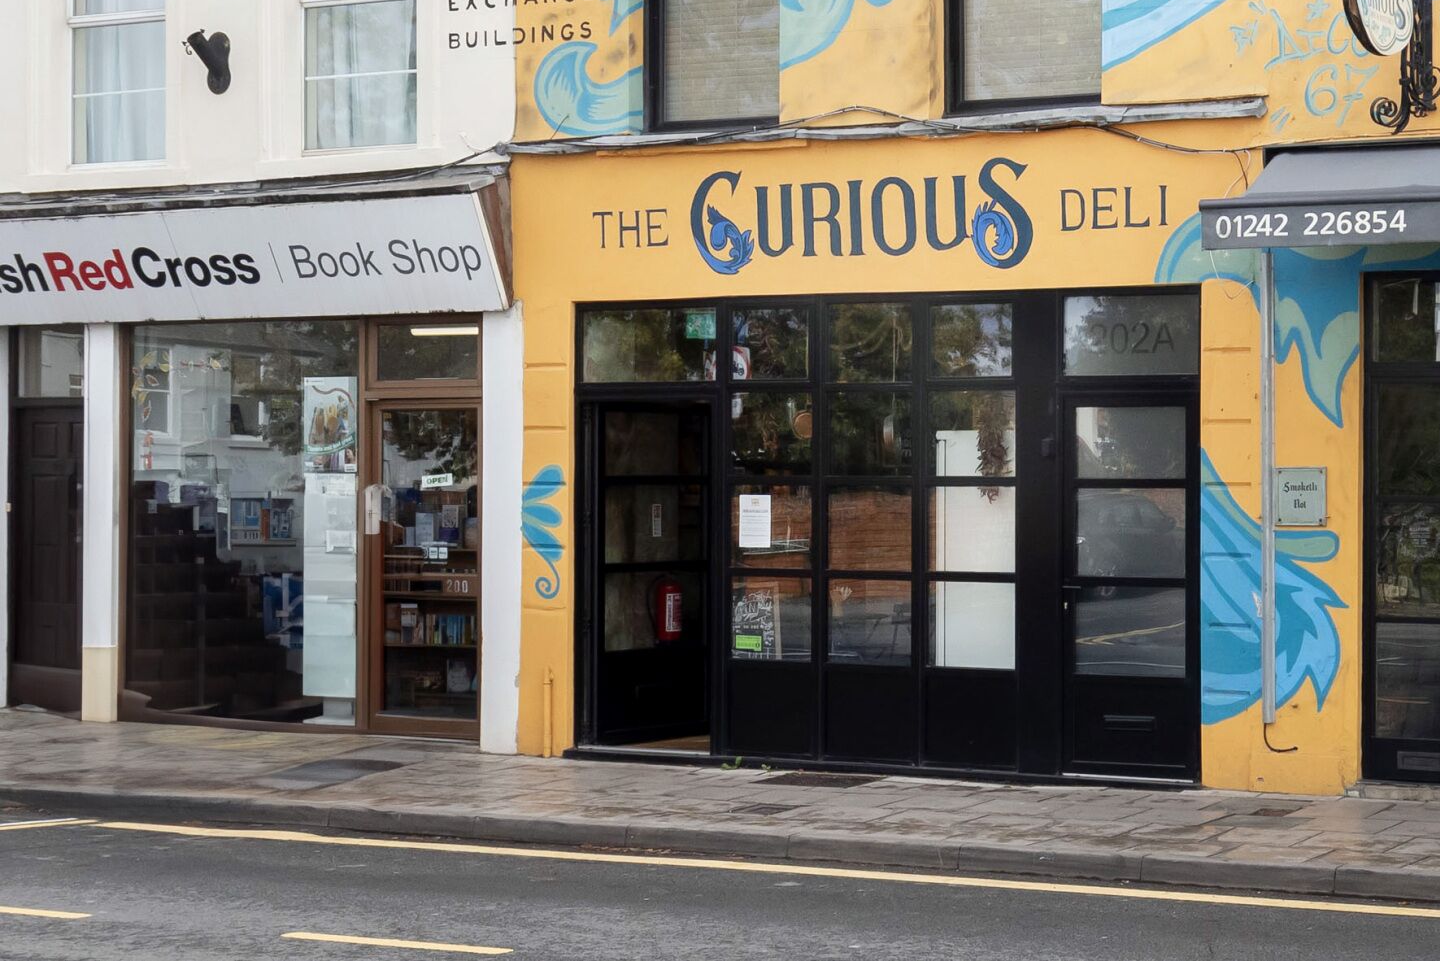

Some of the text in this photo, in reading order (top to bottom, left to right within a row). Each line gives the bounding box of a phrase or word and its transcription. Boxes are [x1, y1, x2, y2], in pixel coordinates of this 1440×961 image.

[448, 21, 593, 50] BUILDINGS
[1304, 63, 1380, 129] 67
[592, 208, 669, 249] THE
[689, 156, 1034, 276] CURIOUS
[1059, 184, 1169, 232] DELI
[1215, 209, 1407, 239] 01242 226854
[288, 241, 383, 279] Book
[387, 238, 482, 281] Shop
[426, 474, 449, 485] OPEN
[446, 579, 469, 594] 200
